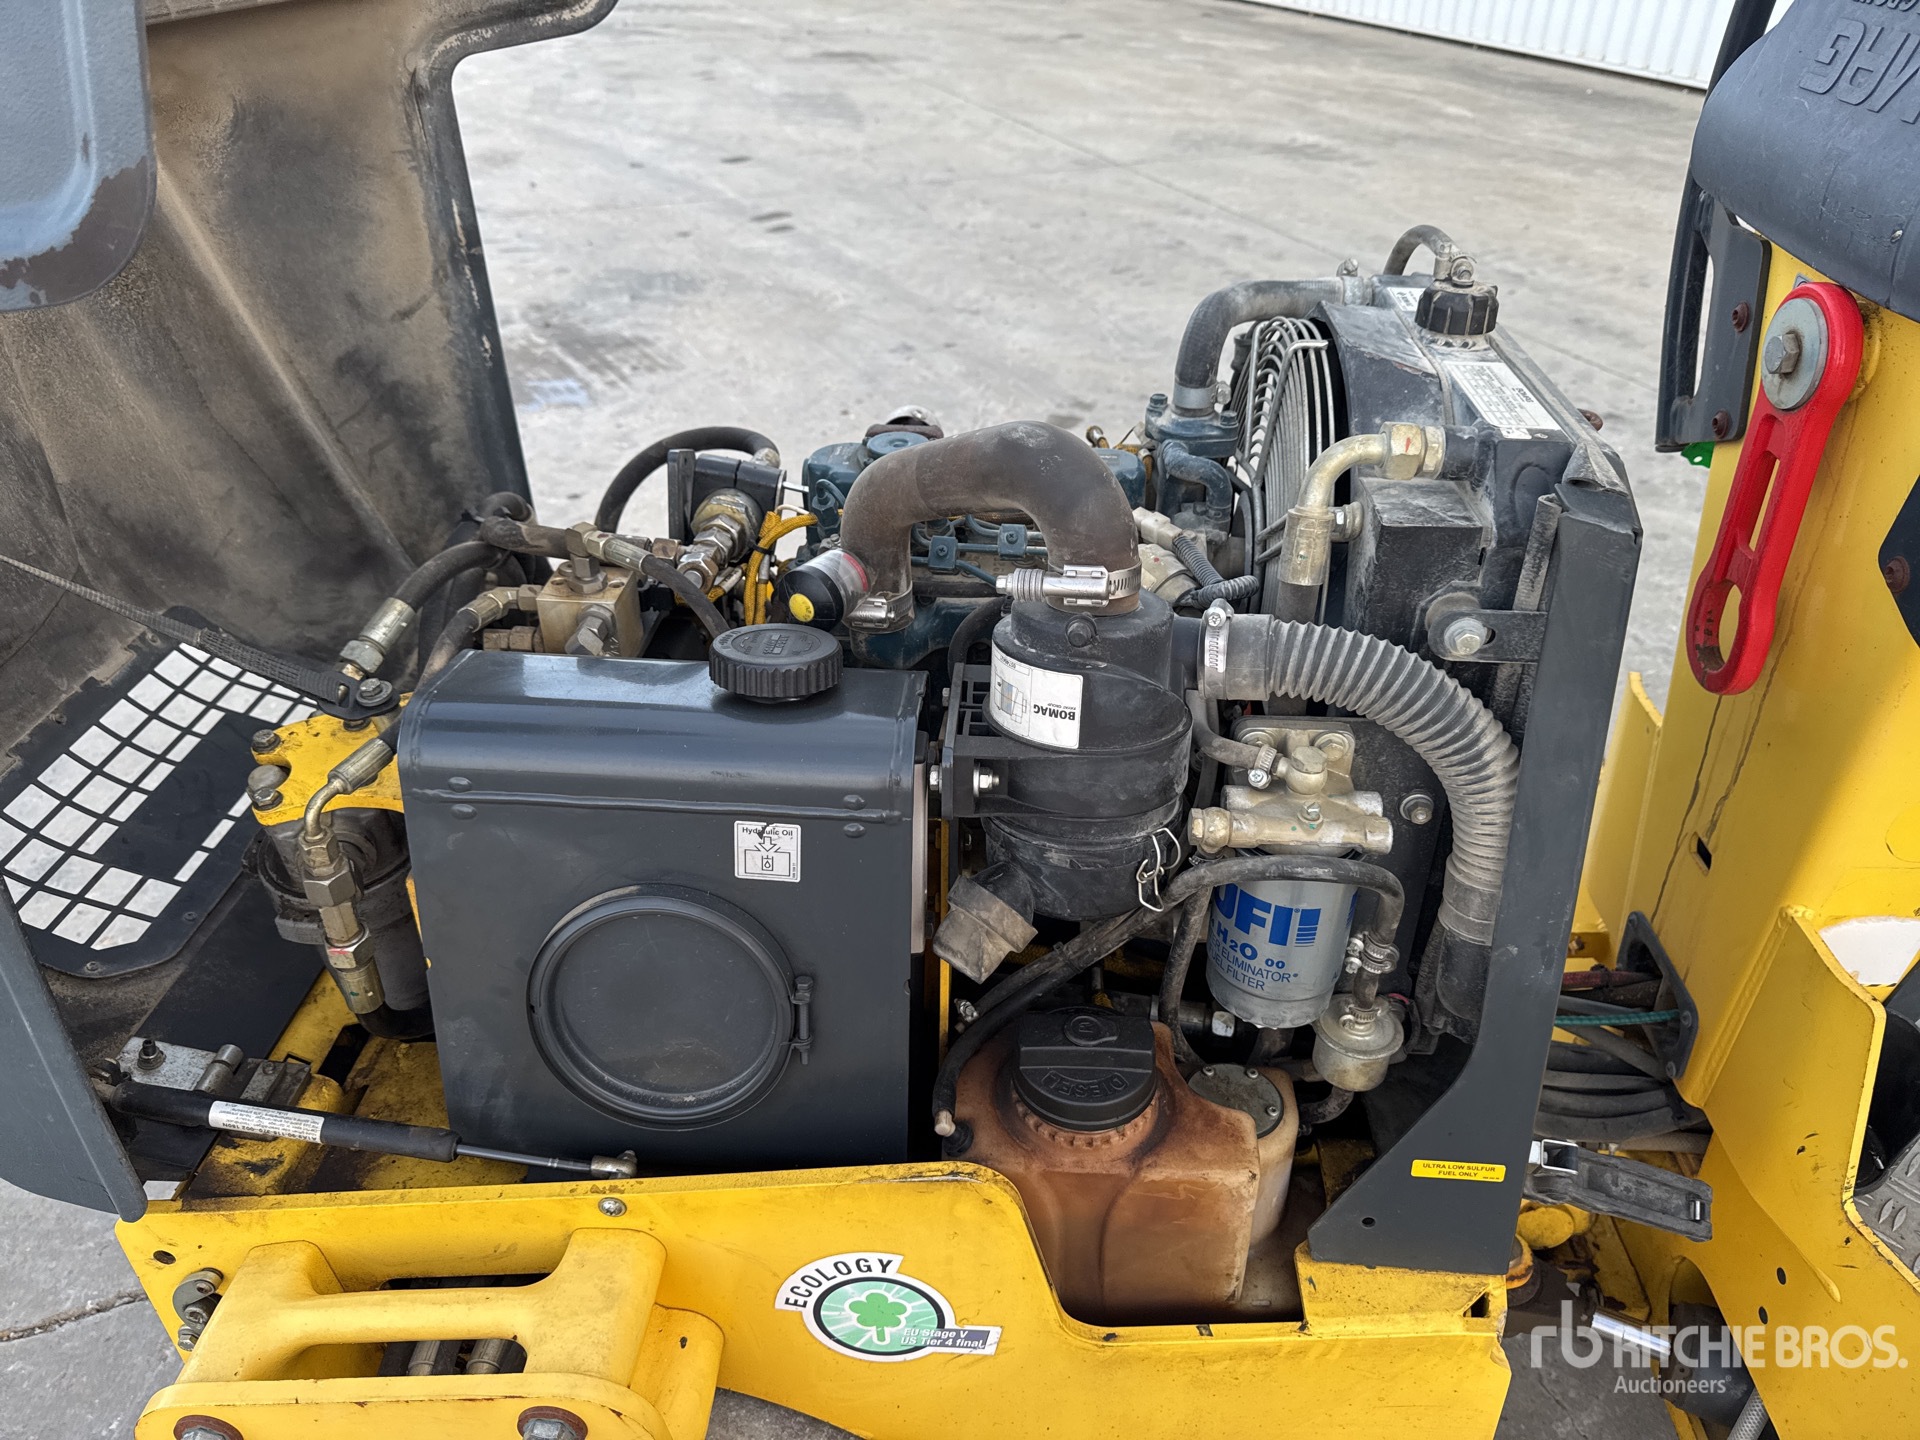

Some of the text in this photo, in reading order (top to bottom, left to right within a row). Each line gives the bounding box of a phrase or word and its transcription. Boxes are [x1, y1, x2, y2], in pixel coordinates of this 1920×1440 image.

[1033, 704, 1076, 721] BOMAG
[1221, 948, 1291, 983] ELIMINATOR
[1226, 965, 1265, 991] FILTER
[1045, 1072, 1128, 1098] DIESEL
[784, 1258, 893, 1309] ECOLOGY
[901, 1337, 984, 1347] US Tier 4 final
[903, 1328, 969, 1339] EU Stage V
